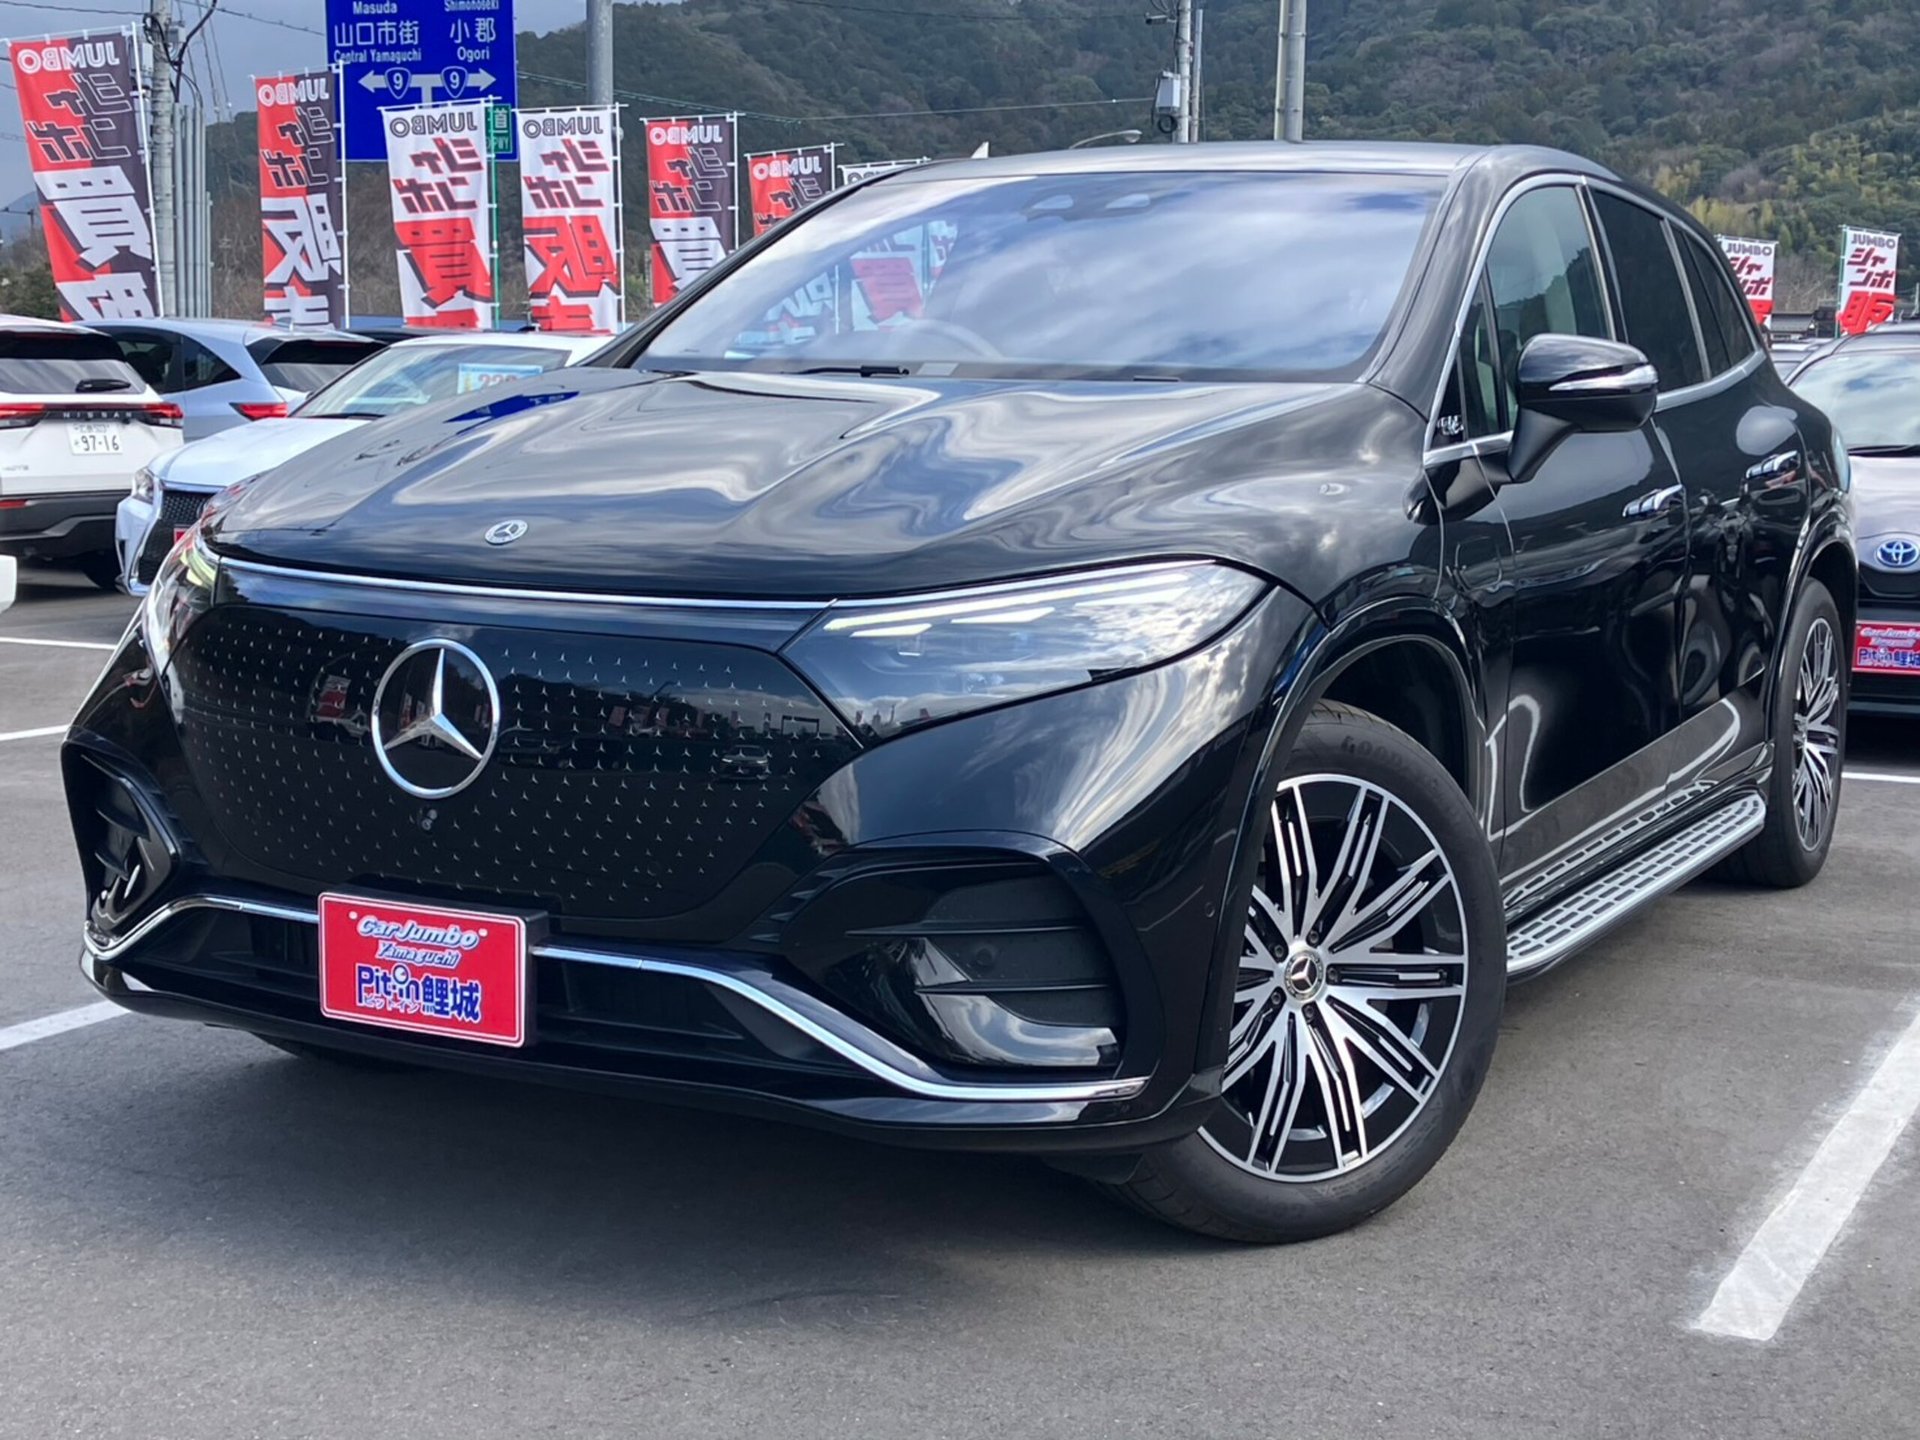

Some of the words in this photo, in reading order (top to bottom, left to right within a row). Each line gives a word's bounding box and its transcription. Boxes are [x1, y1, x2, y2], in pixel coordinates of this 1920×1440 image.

[353, 1, 397, 14] Masuda
[334, 20, 420, 47] 山口市街
[450, 17, 496, 44] 小郡
[334, 50, 367, 63] Central
[370, 49, 422, 64] Yamaguchi
[457, 46, 490, 63] Ogori
[392, 73, 403, 90] 9
[451, 71, 460, 89] 9
[1851, 234, 1896, 249] JUMBO
[1726, 243, 1772, 257] JUMBO
[63, 411, 132, 419] NISSAN
[81, 435, 119, 451] 97-16
[376, 942, 461, 969] Yamaguchi
